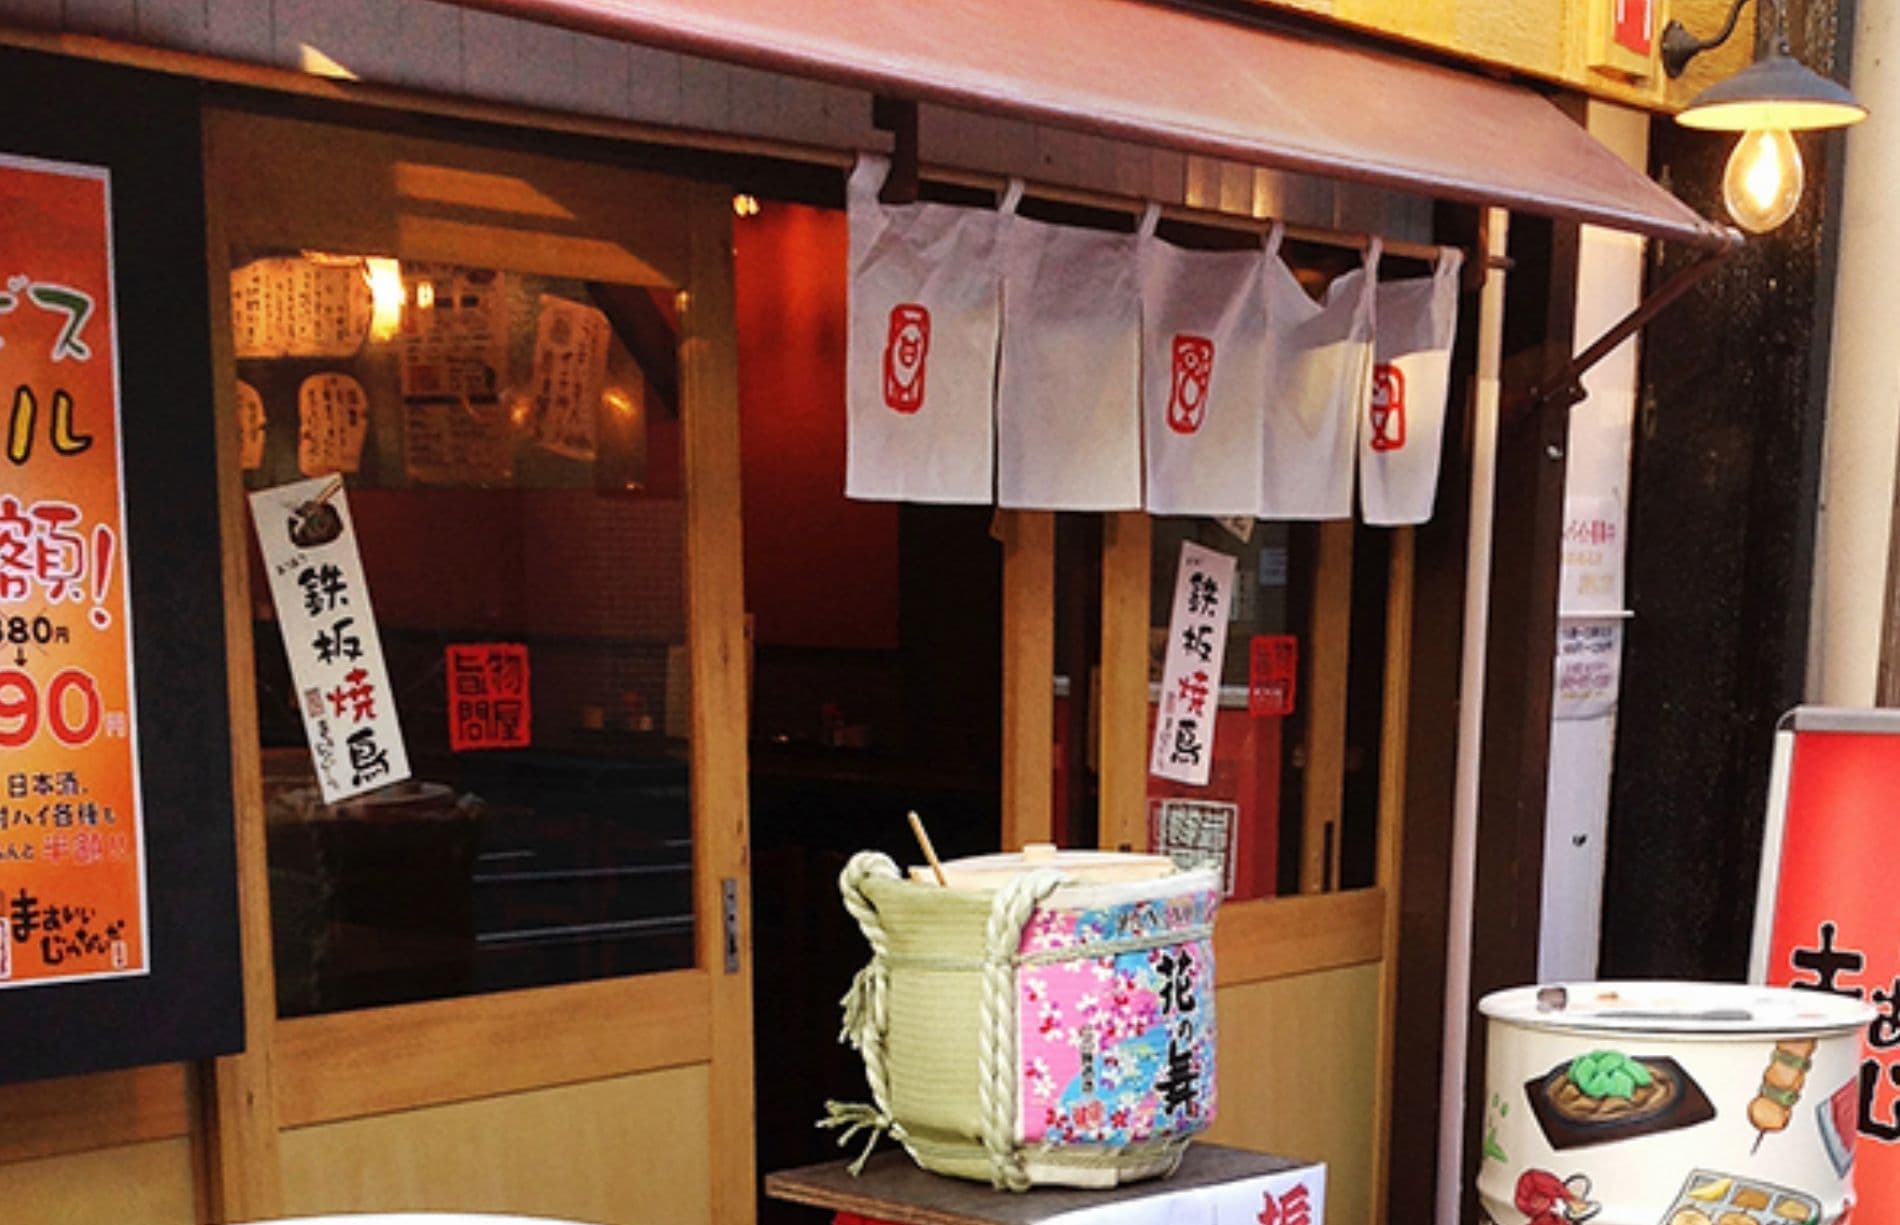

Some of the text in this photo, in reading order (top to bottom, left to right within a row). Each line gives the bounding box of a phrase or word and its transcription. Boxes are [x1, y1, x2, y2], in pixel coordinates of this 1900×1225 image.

[0, 275, 94, 362] ス
[0, 616, 70, 644] 80円
[297, 563, 390, 788] 鉄板焼鳥
[1155, 949, 1200, 1116] 花の舞
